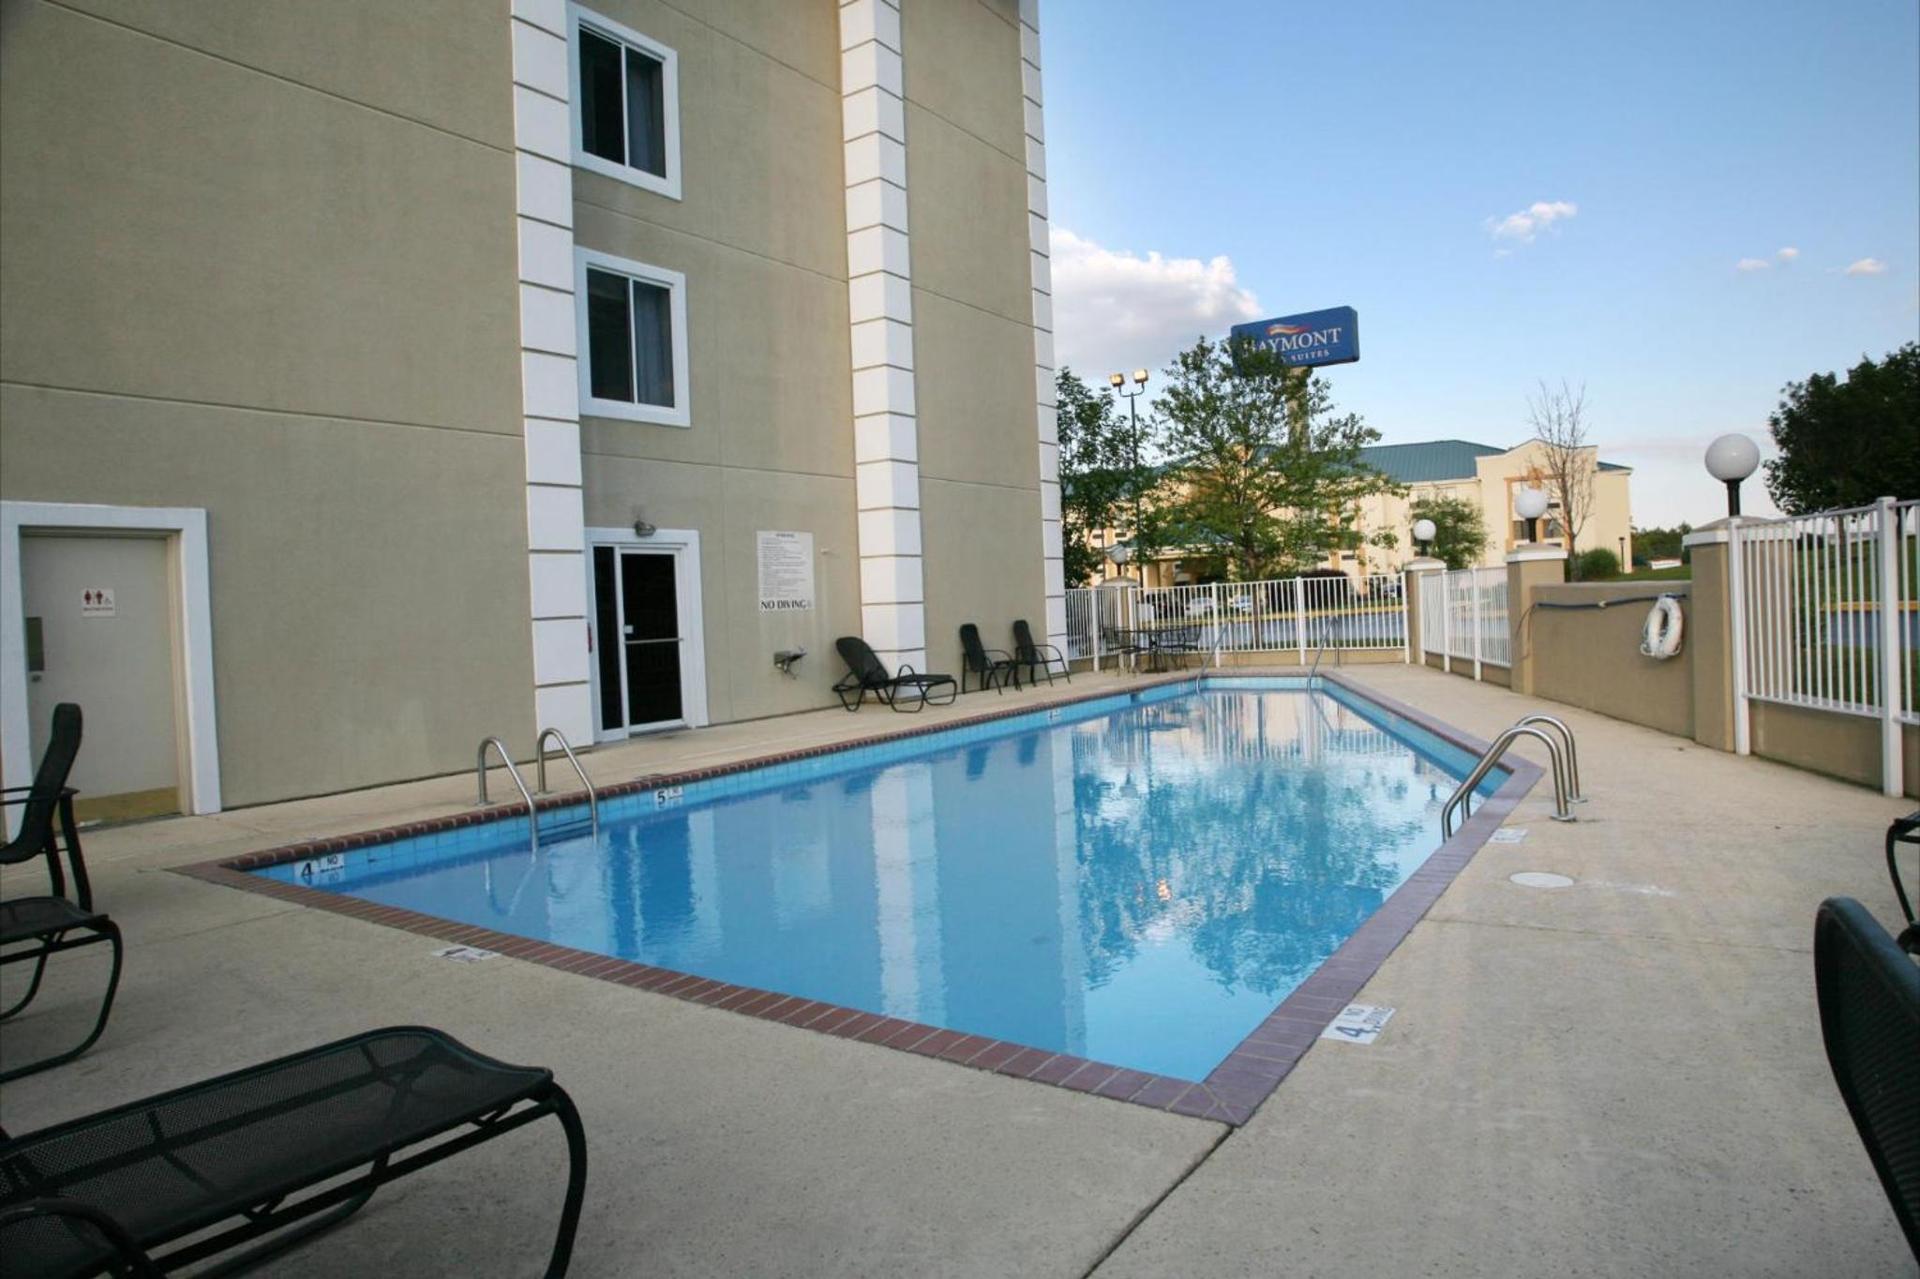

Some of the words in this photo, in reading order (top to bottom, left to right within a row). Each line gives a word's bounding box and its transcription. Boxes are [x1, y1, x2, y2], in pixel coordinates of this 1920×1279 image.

[1291, 348, 1330, 361] SUITES
[761, 599, 775, 609] NO
[777, 599, 807, 609] DIVING
[657, 790, 666, 805] 5
[301, 861, 314, 878] 4
[1335, 1025, 1378, 1038] 4
